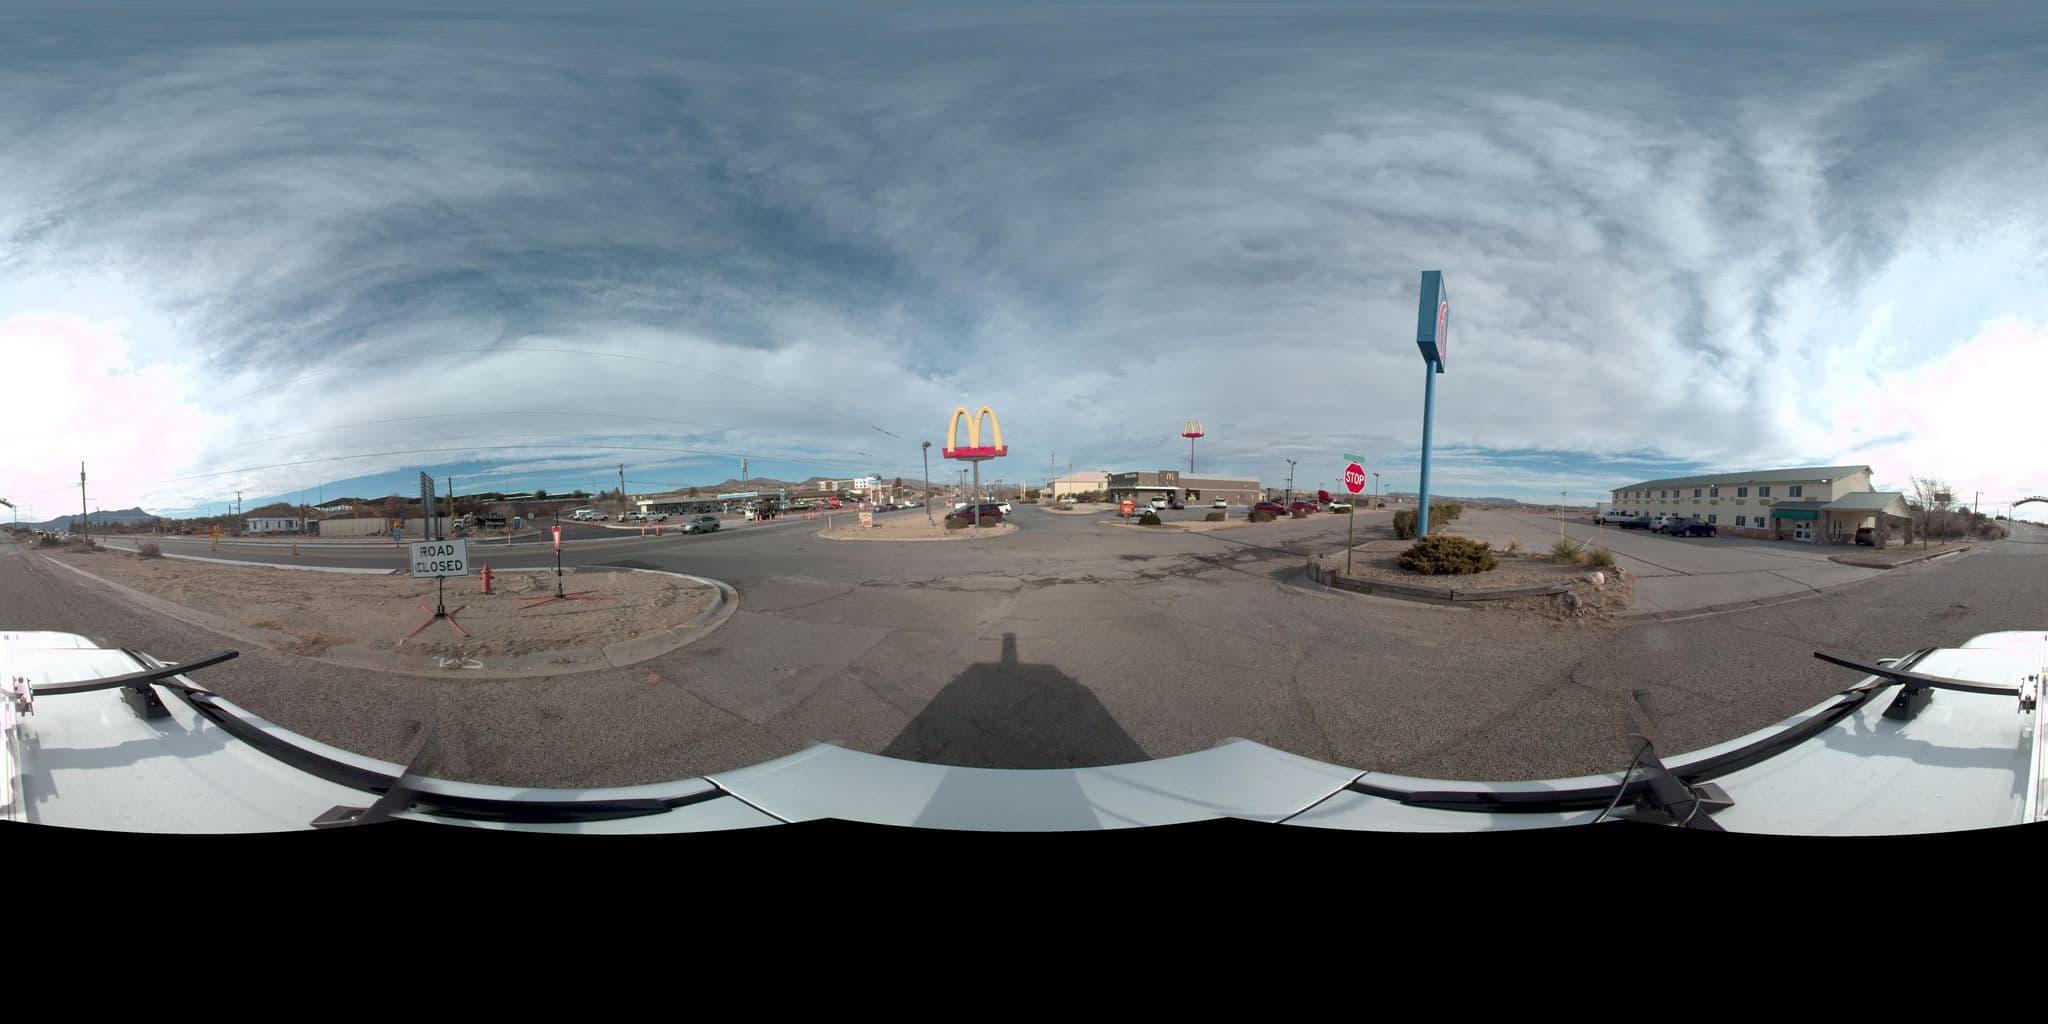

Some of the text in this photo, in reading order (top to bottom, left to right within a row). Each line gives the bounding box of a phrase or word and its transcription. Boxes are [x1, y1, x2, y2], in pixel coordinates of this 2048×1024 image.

[1346, 470, 1365, 485] STOP
[420, 545, 454, 557] ROAD
[415, 560, 463, 572] CLOSED
